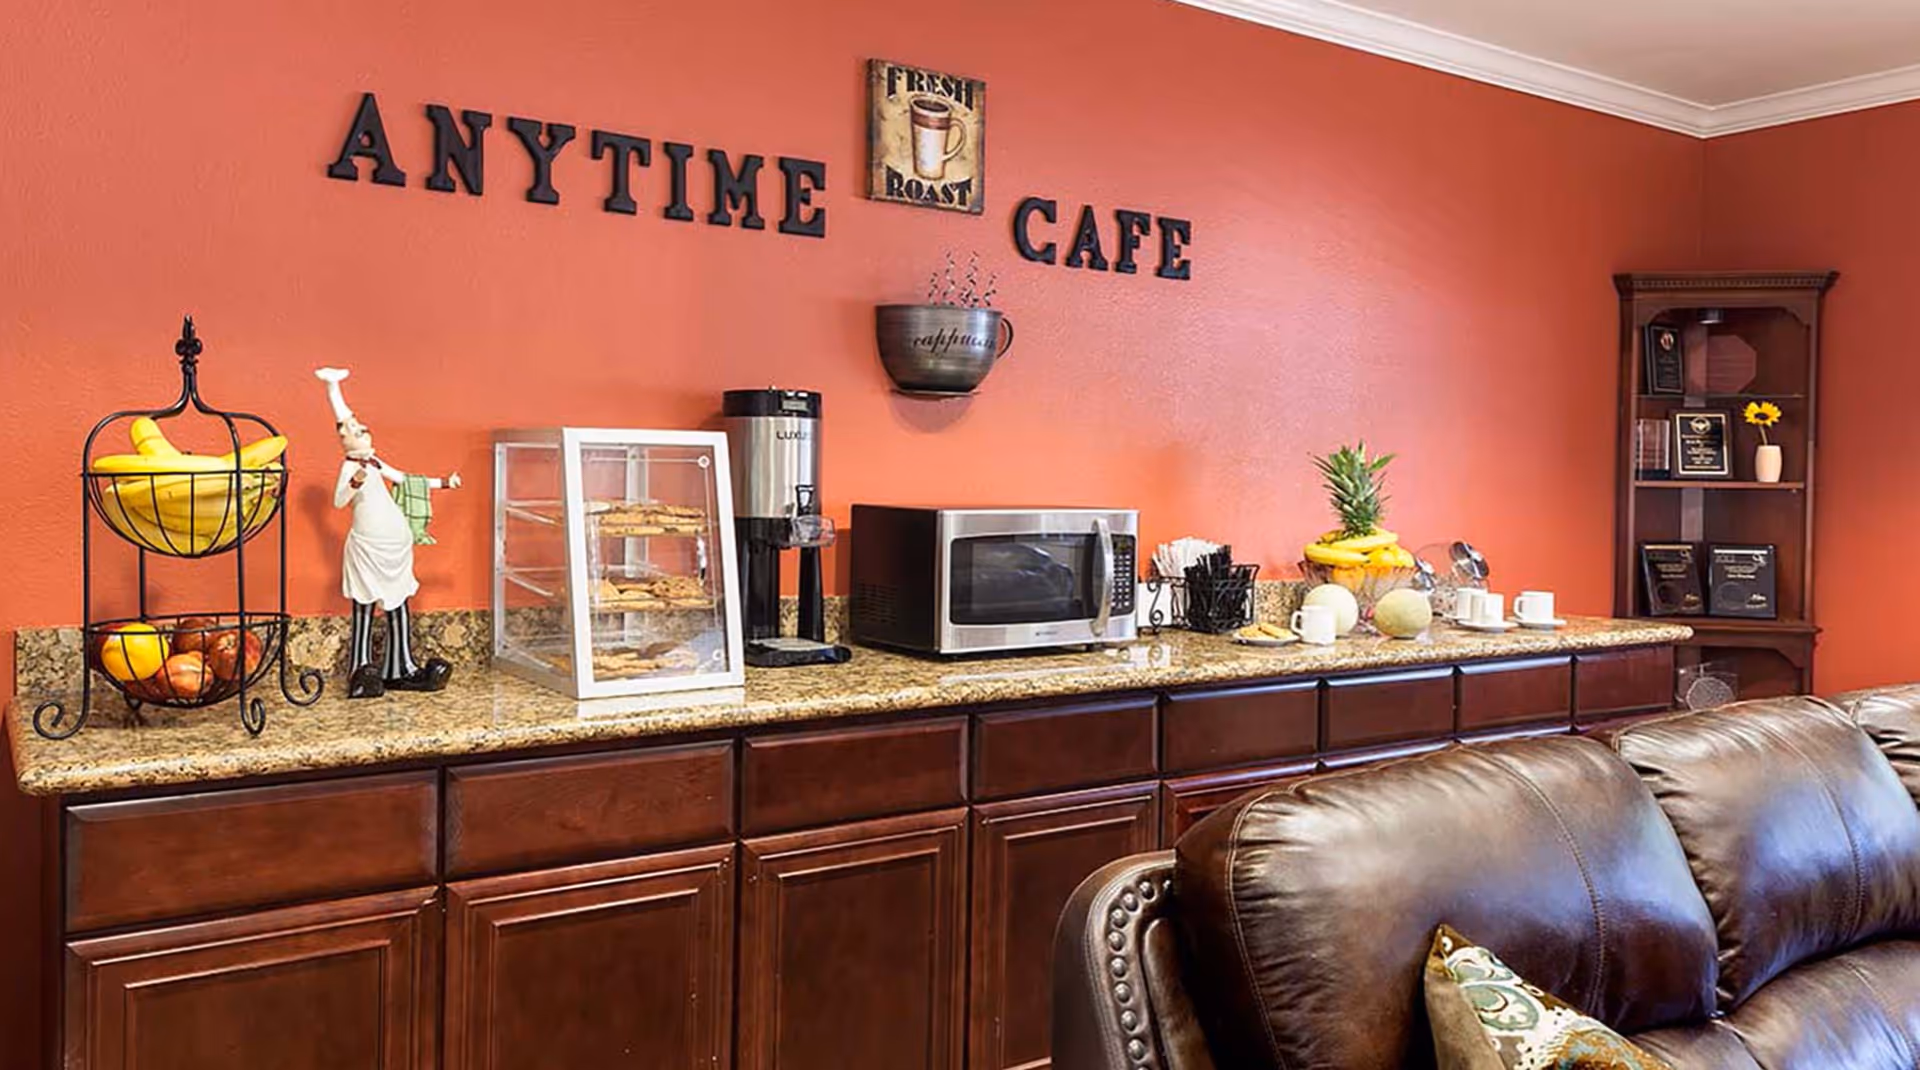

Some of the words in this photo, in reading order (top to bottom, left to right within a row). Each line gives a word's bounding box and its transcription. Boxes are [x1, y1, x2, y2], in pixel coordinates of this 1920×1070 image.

[886, 66, 974, 112] FRESH
[328, 92, 826, 238] ANYTIME
[886, 164, 972, 206] ROAST
[1012, 197, 1192, 280] CAFE
